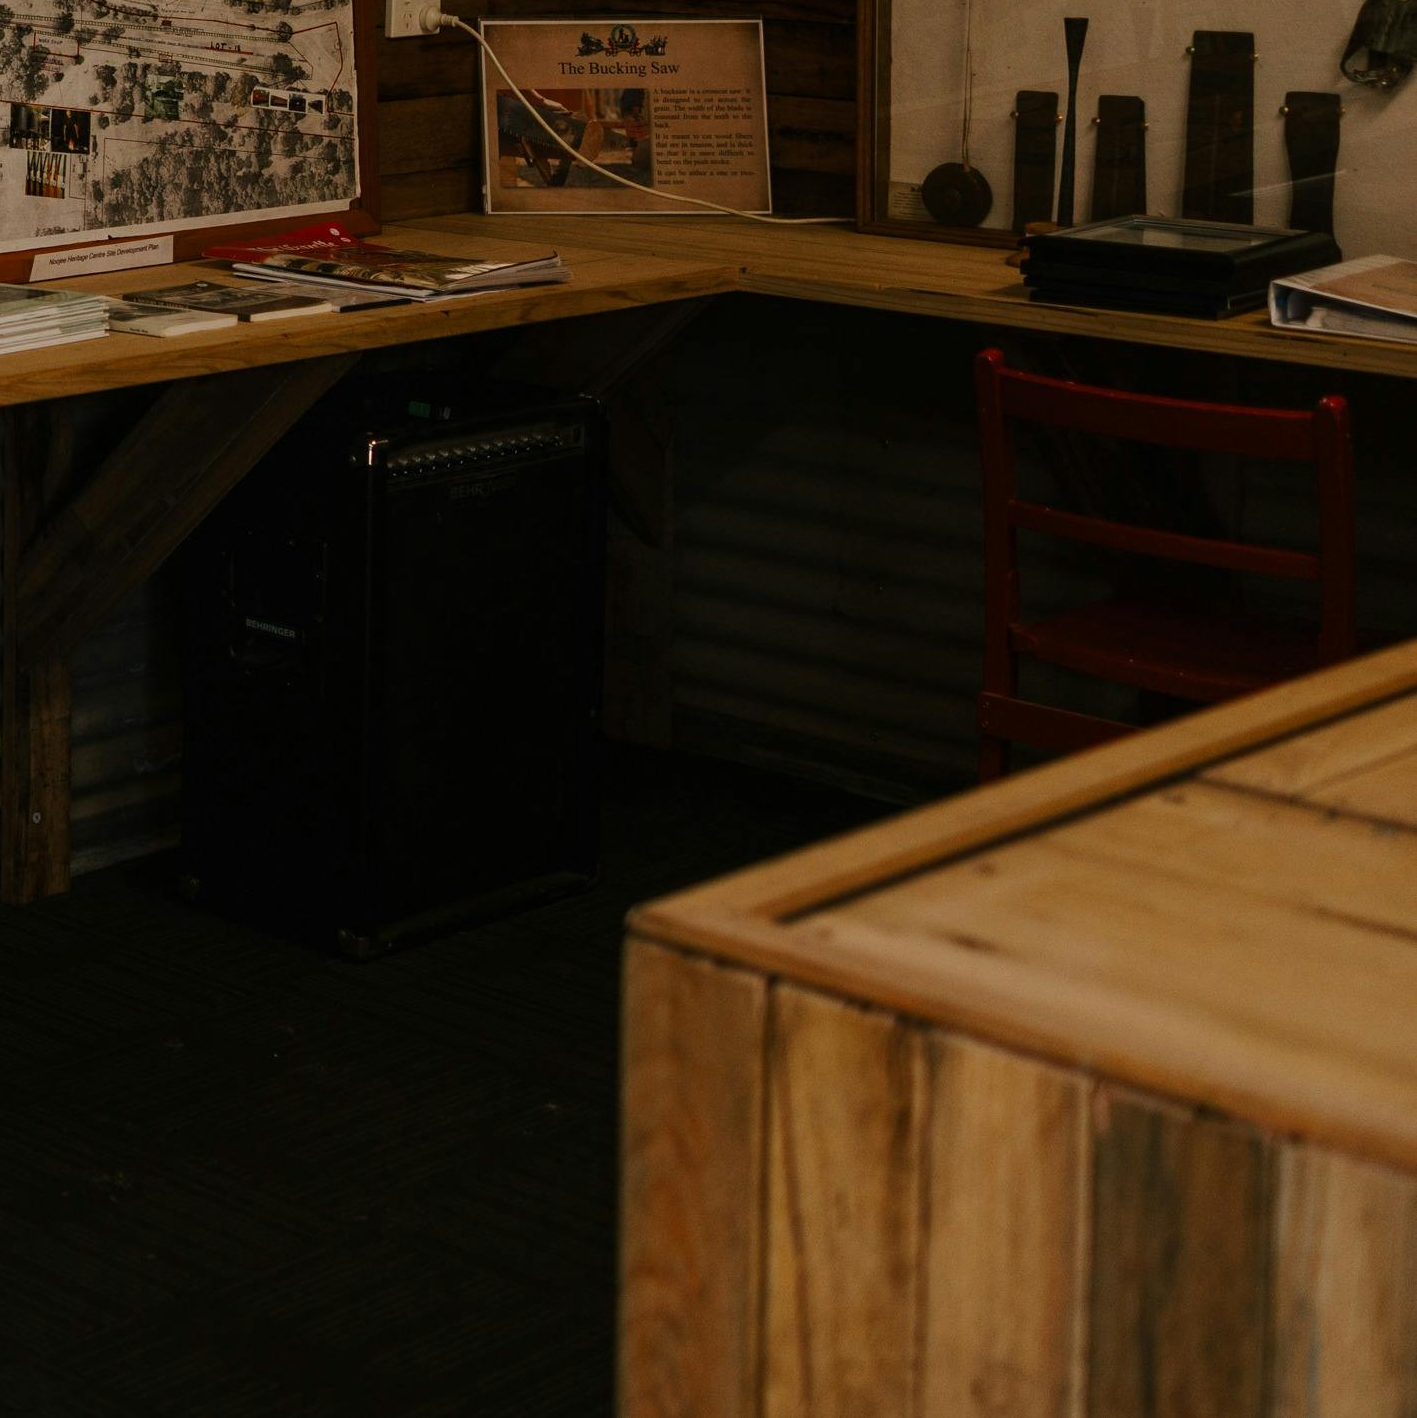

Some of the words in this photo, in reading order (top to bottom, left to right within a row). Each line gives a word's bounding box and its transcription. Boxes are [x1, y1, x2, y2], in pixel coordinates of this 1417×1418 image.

[558, 62, 585, 74] The
[589, 61, 647, 77] Bucking
[651, 62, 680, 74] Saw
[67, 254, 88, 262] Heritage
[117, 246, 147, 256] Development
